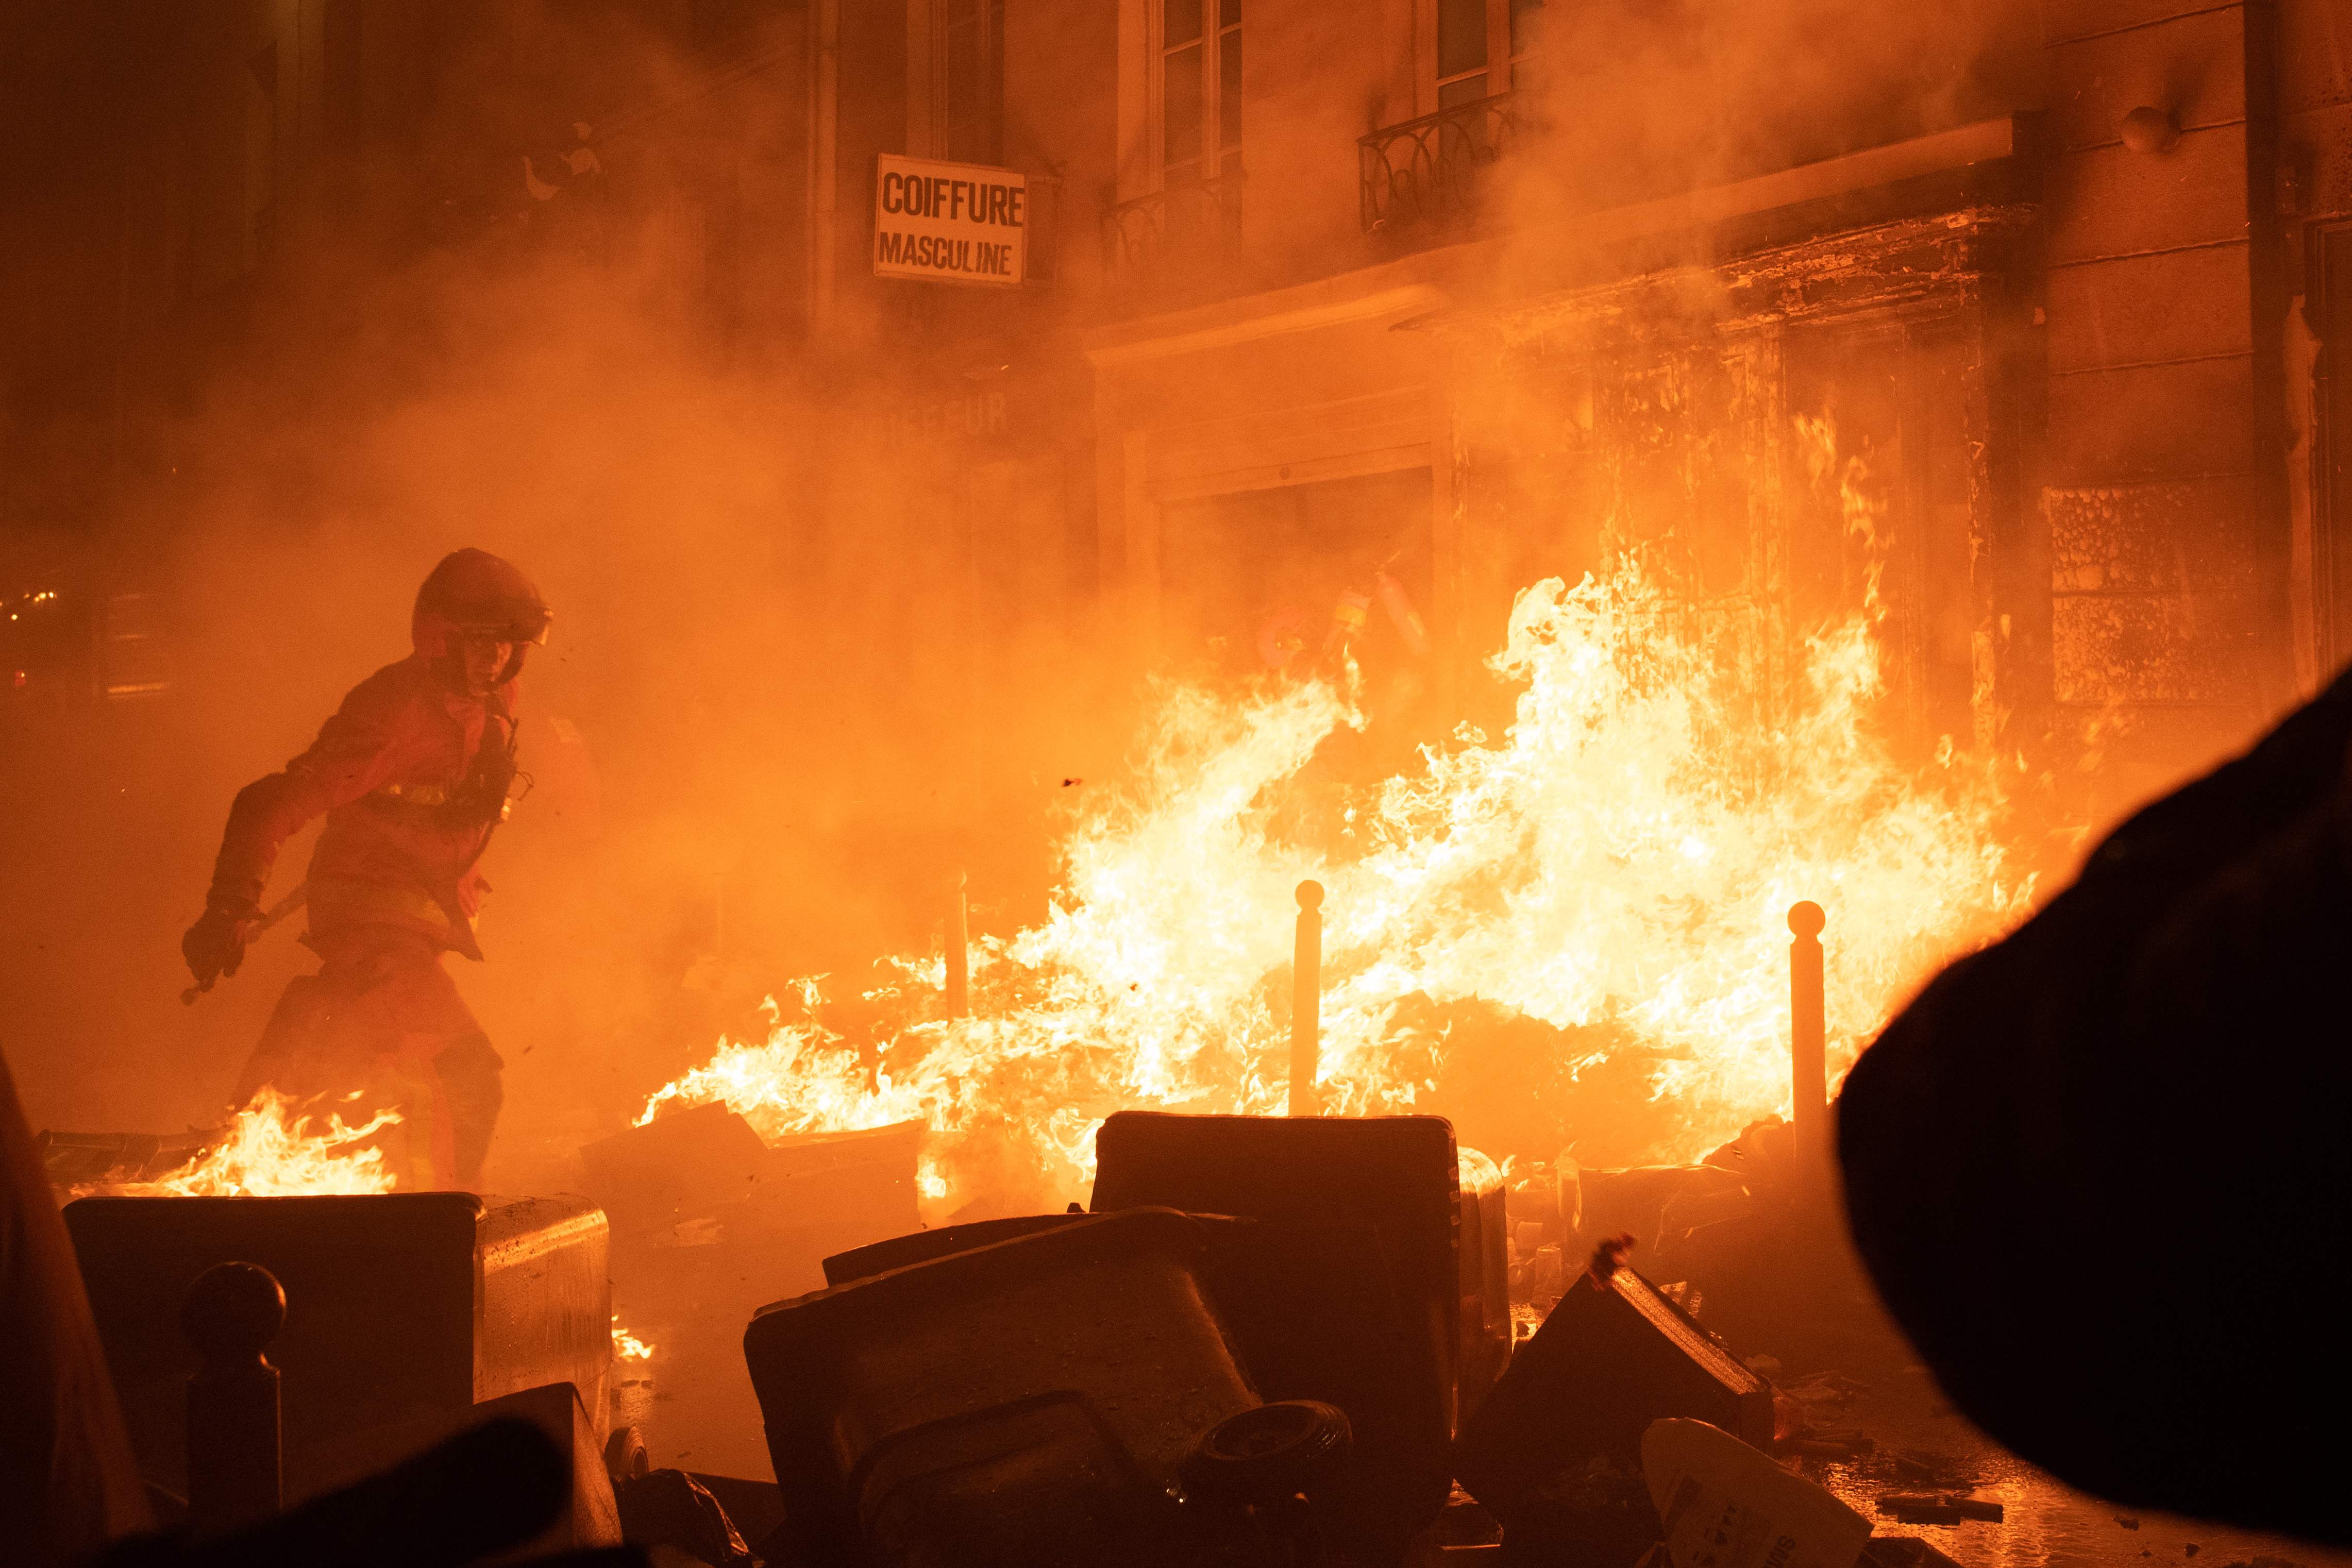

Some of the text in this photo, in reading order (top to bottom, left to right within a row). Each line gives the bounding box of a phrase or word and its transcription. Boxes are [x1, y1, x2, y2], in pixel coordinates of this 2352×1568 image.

[883, 172, 1025, 227] COIFFURE
[879, 231, 1012, 276] MASCULINE
[1762, 1535, 1796, 1568] WS
